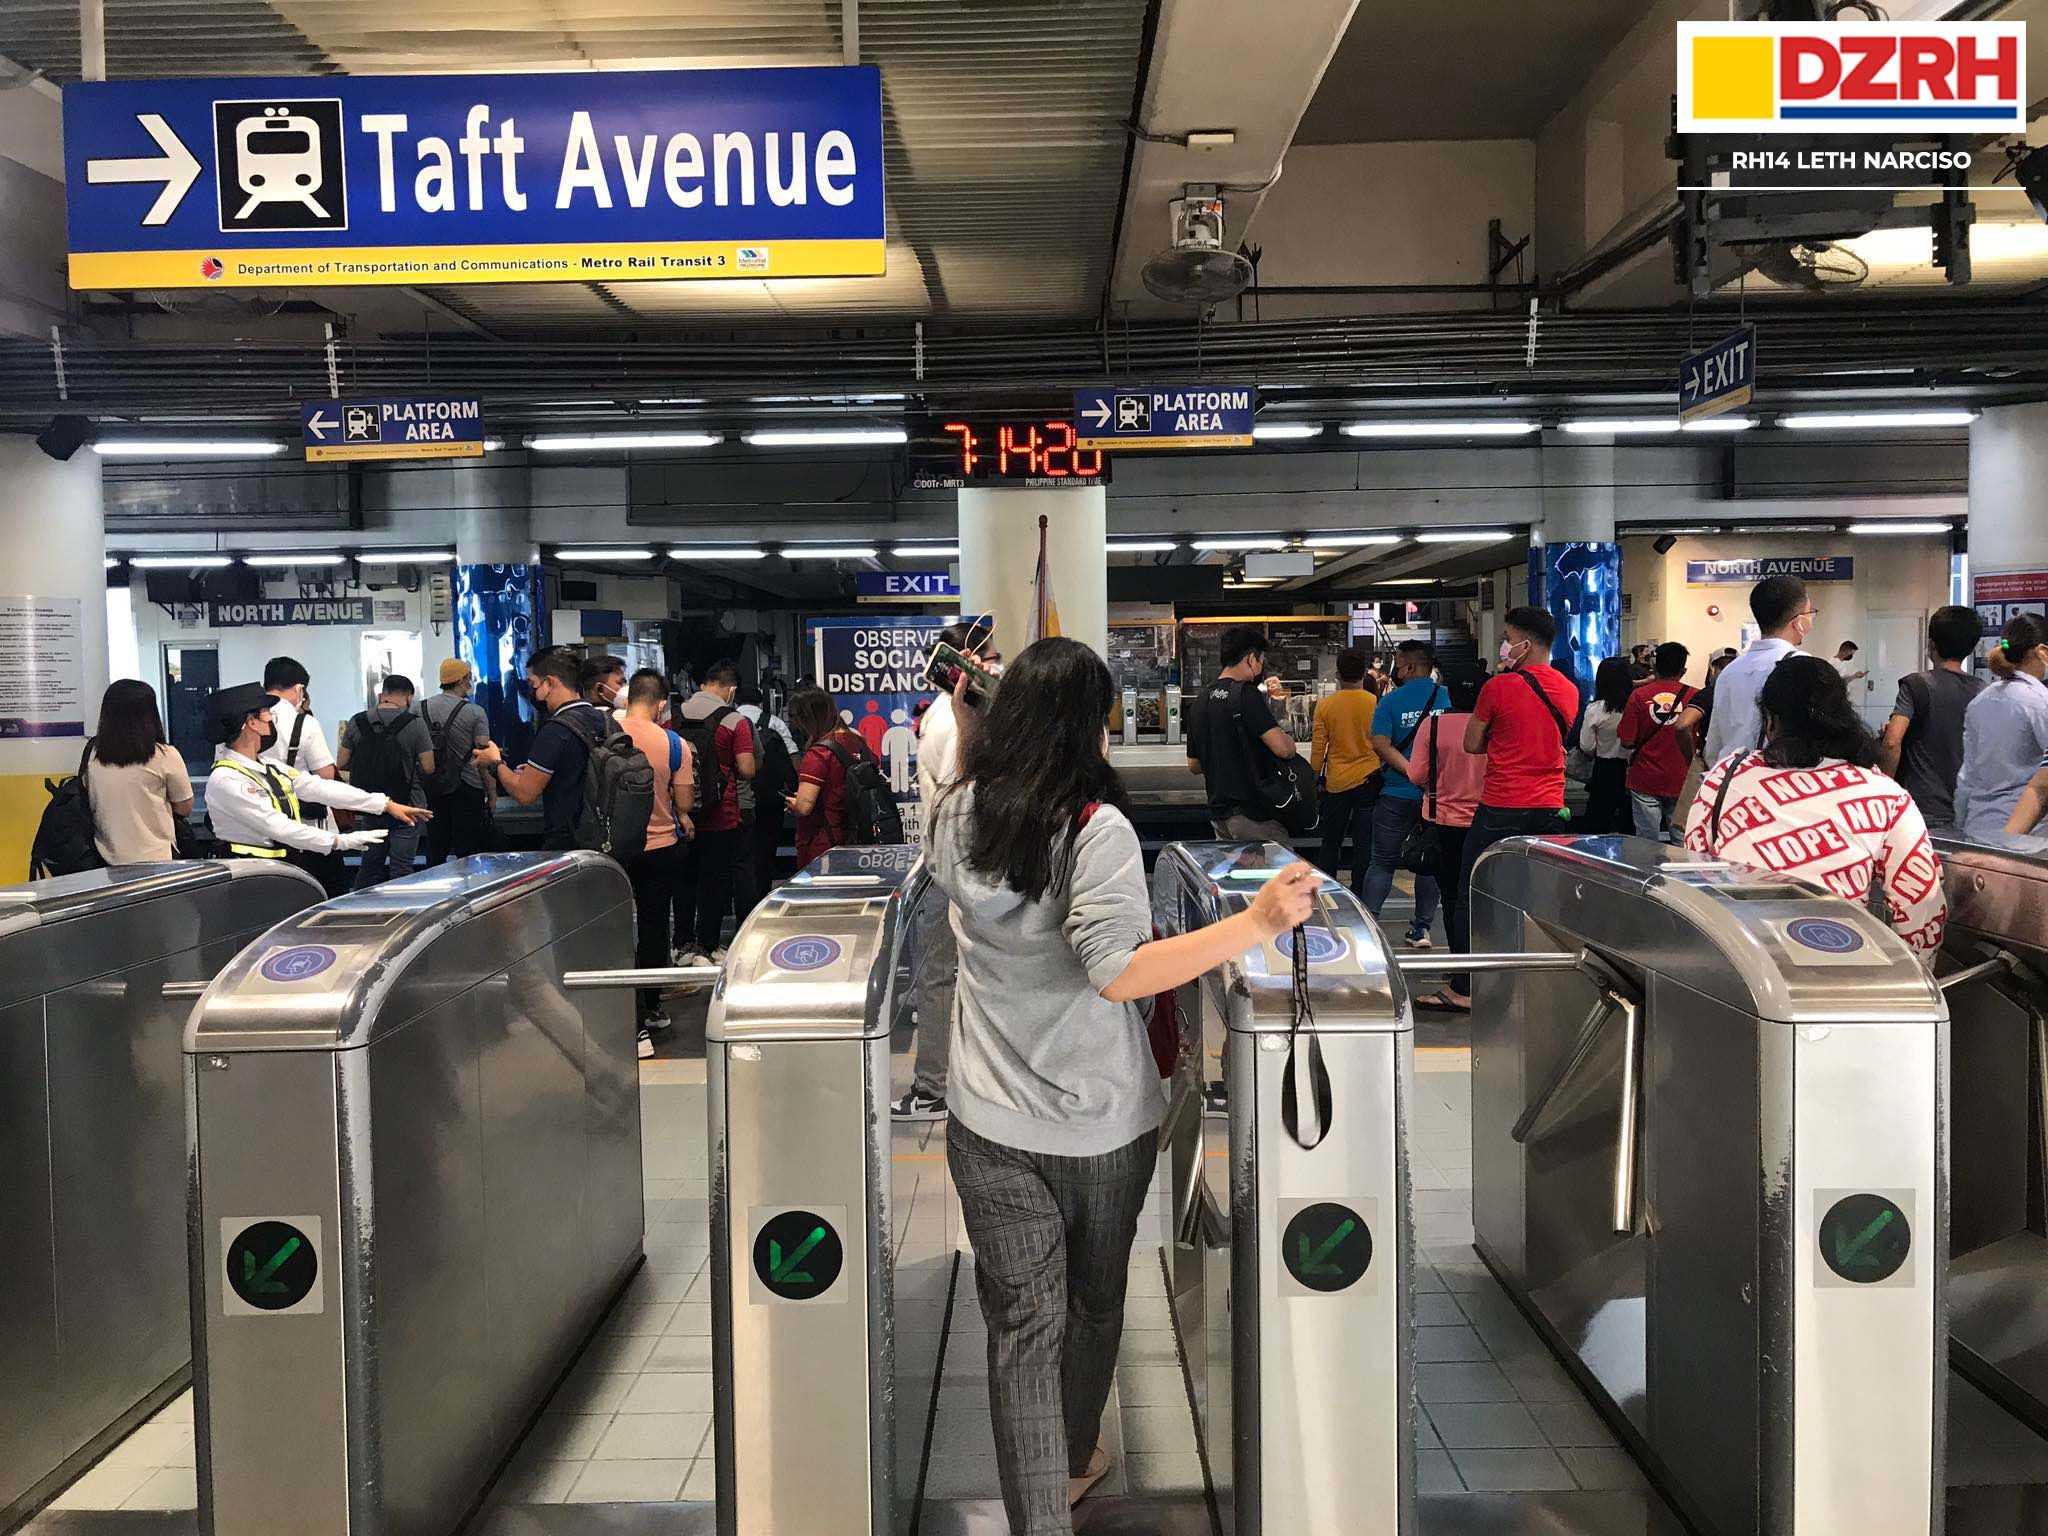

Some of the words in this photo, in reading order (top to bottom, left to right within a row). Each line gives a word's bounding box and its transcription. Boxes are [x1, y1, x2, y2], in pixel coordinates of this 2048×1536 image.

[361, 104, 527, 213] Taft
[555, 111, 856, 209] Avenue
[238, 262, 314, 276] Department
[318, 262, 330, 273] of
[334, 261, 429, 274] Transportation
[433, 260, 457, 271] and
[460, 258, 569, 271] Communications
[581, 257, 623, 269] Metro
[628, 256, 656, 268] Rail
[660, 255, 713, 267] Transit
[717, 255, 726, 266] 3
[1704, 341, 1749, 395] EXIT
[382, 401, 479, 421] PLATFORM
[1153, 391, 1249, 412] PLATFORM
[405, 422, 455, 441] AREA
[1174, 413, 1224, 431] AREA
[1705, 561, 1761, 575] NORTH
[1767, 560, 1835, 574] AVENUE
[885, 575, 949, 592] EXIT
[218, 605, 284, 622] NORTH
[291, 603, 364, 620] AVENUE
[854, 629, 941, 647] OBSERVE
[854, 650, 928, 669] SOCIA
[1765, 765, 1864, 801] NOPE
[902, 818, 920, 831] ith
[904, 832, 921, 844] he
[1757, 821, 1845, 870] NOPE
[1895, 840, 1935, 900] NOP
